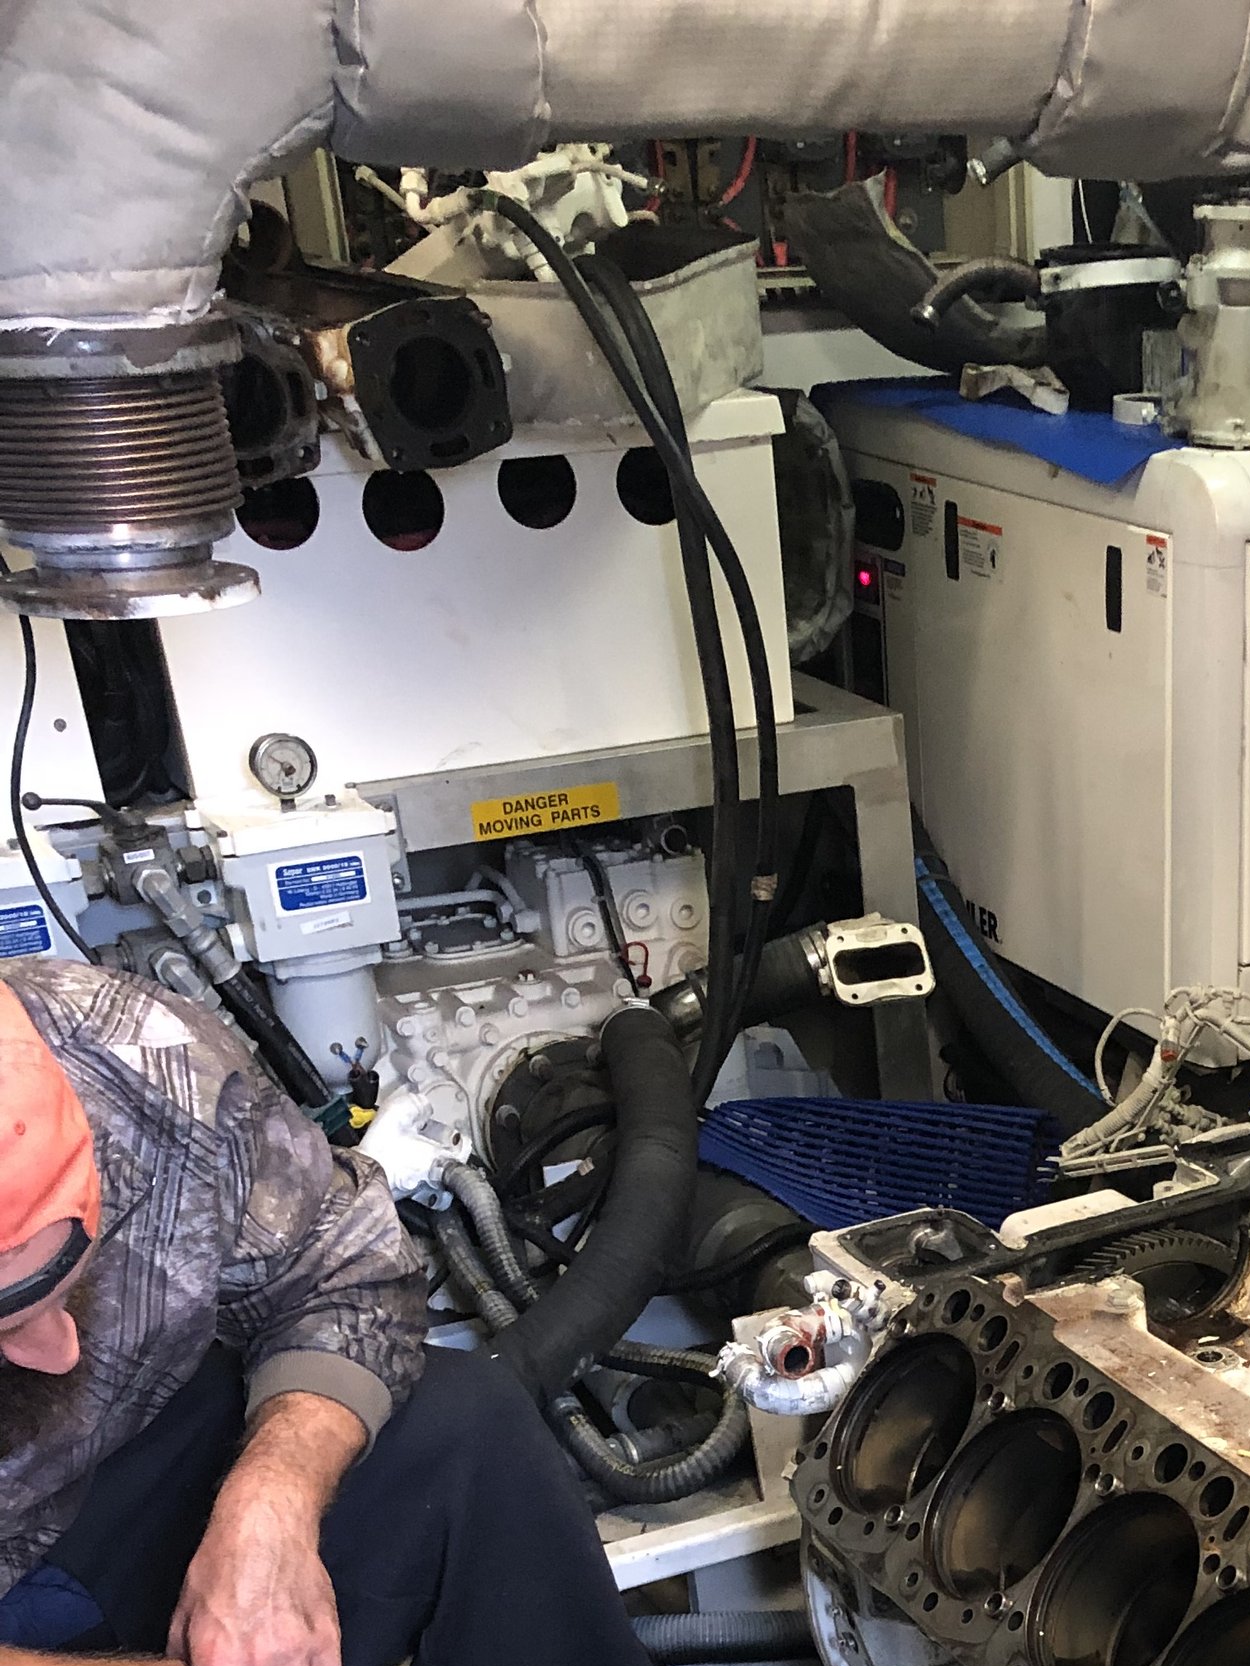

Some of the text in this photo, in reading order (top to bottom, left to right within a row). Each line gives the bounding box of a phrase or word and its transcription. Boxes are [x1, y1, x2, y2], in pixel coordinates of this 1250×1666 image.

[502, 793, 569, 815] DANGER
[479, 805, 601, 835] MOVING PARTS
